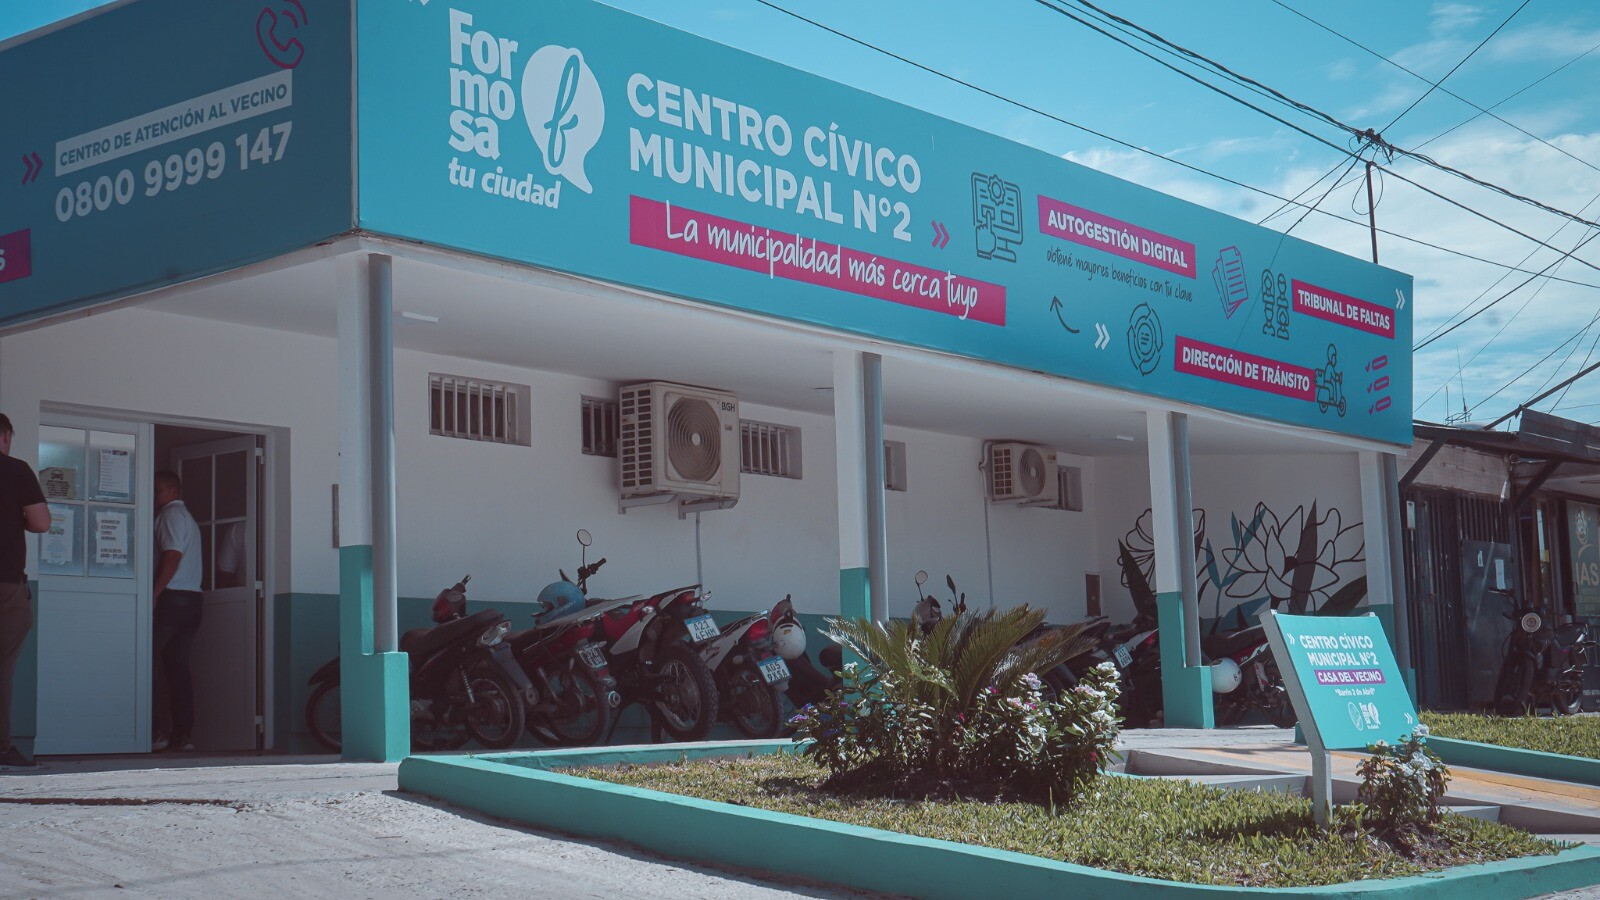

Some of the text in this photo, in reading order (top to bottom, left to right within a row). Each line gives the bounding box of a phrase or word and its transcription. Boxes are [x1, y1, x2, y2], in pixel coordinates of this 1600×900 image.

[449, 8, 518, 80] For
[450, 67, 515, 120] mo
[59, 83, 287, 167] CENTRO DE ATENCIÓN AL VECINO
[448, 110, 500, 160] sa
[626, 72, 921, 194] CENTRO CÍVICO
[55, 121, 293, 222] 0800 9999 147
[448, 157, 561, 209] tu ciudad
[629, 127, 844, 226] MUNICIPAL
[665, 200, 978, 320] La municipalidad más cerca tuyo
[1048, 210, 1188, 268] AUTOGESTIÓN DIGITAL
[1047, 246, 1193, 302] obtené mayores beneficios con tu clave
[1298, 290, 1390, 330] TRIBUNAL DE FALTAS
[1182, 347, 1310, 391] DIRECCIÓN DE TRÁNSITO
[721, 402, 735, 412] BGH
[1300, 632, 1373, 649] CENTRO CÍVICO
[1307, 652, 1360, 666] MUNICIPAL
[1318, 671, 1382, 682] CASA DEL VECINO
